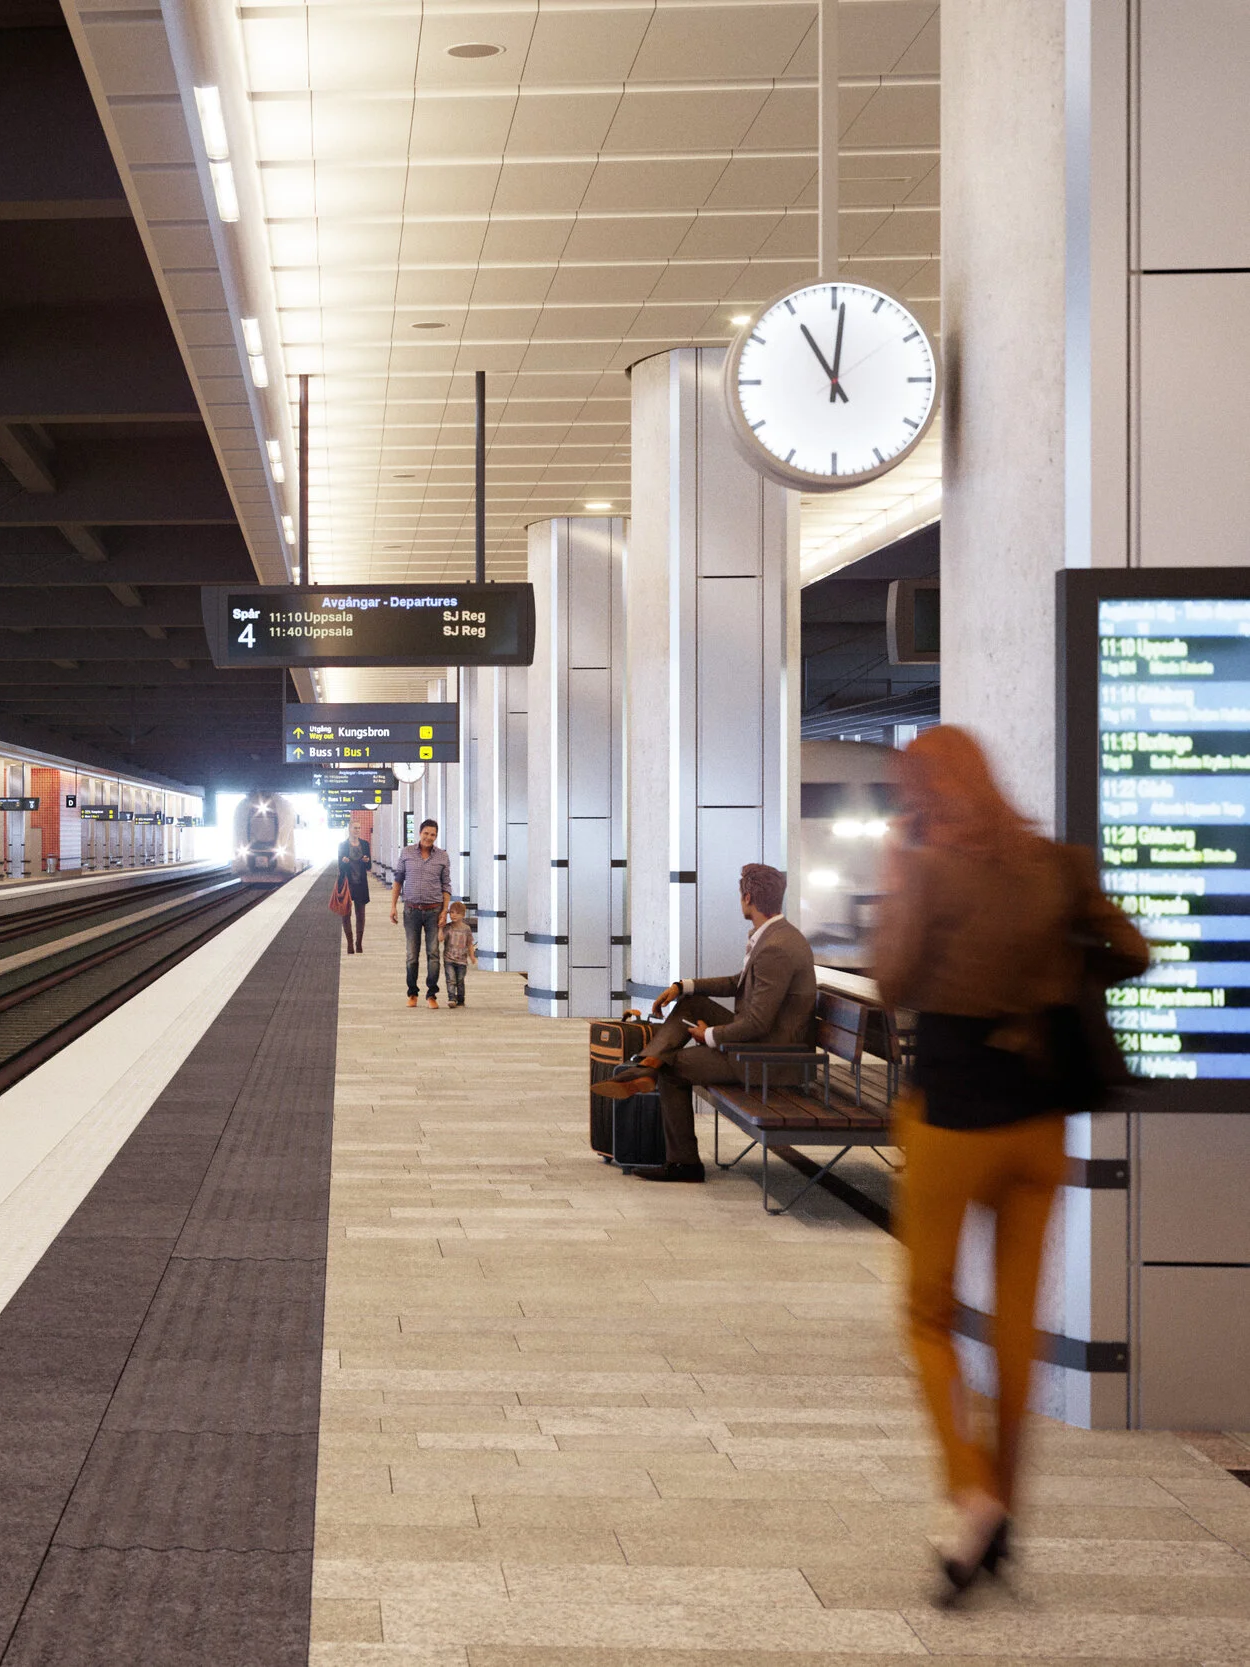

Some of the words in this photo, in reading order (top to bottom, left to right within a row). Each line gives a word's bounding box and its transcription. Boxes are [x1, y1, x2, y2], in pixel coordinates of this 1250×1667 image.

[322, 596, 381, 610] Avgångar
[390, 597, 458, 609] Departures
[232, 608, 261, 621] Spår
[269, 612, 302, 622] 11:10
[304, 611, 353, 624] Uppsala
[443, 611, 459, 621] SJ
[461, 611, 486, 623] Reg
[237, 623, 256, 648] 4
[269, 627, 302, 637] 11:40
[304, 626, 353, 639] Uppsala
[443, 626, 459, 636] SJ
[461, 626, 486, 638] Reg
[309, 726, 332, 734] Utgång
[338, 726, 390, 739] Kungsbron
[309, 747, 332, 757] Buss
[335, 747, 341, 757] 1
[343, 747, 362, 757] Bus
[364, 747, 370, 757] 1
